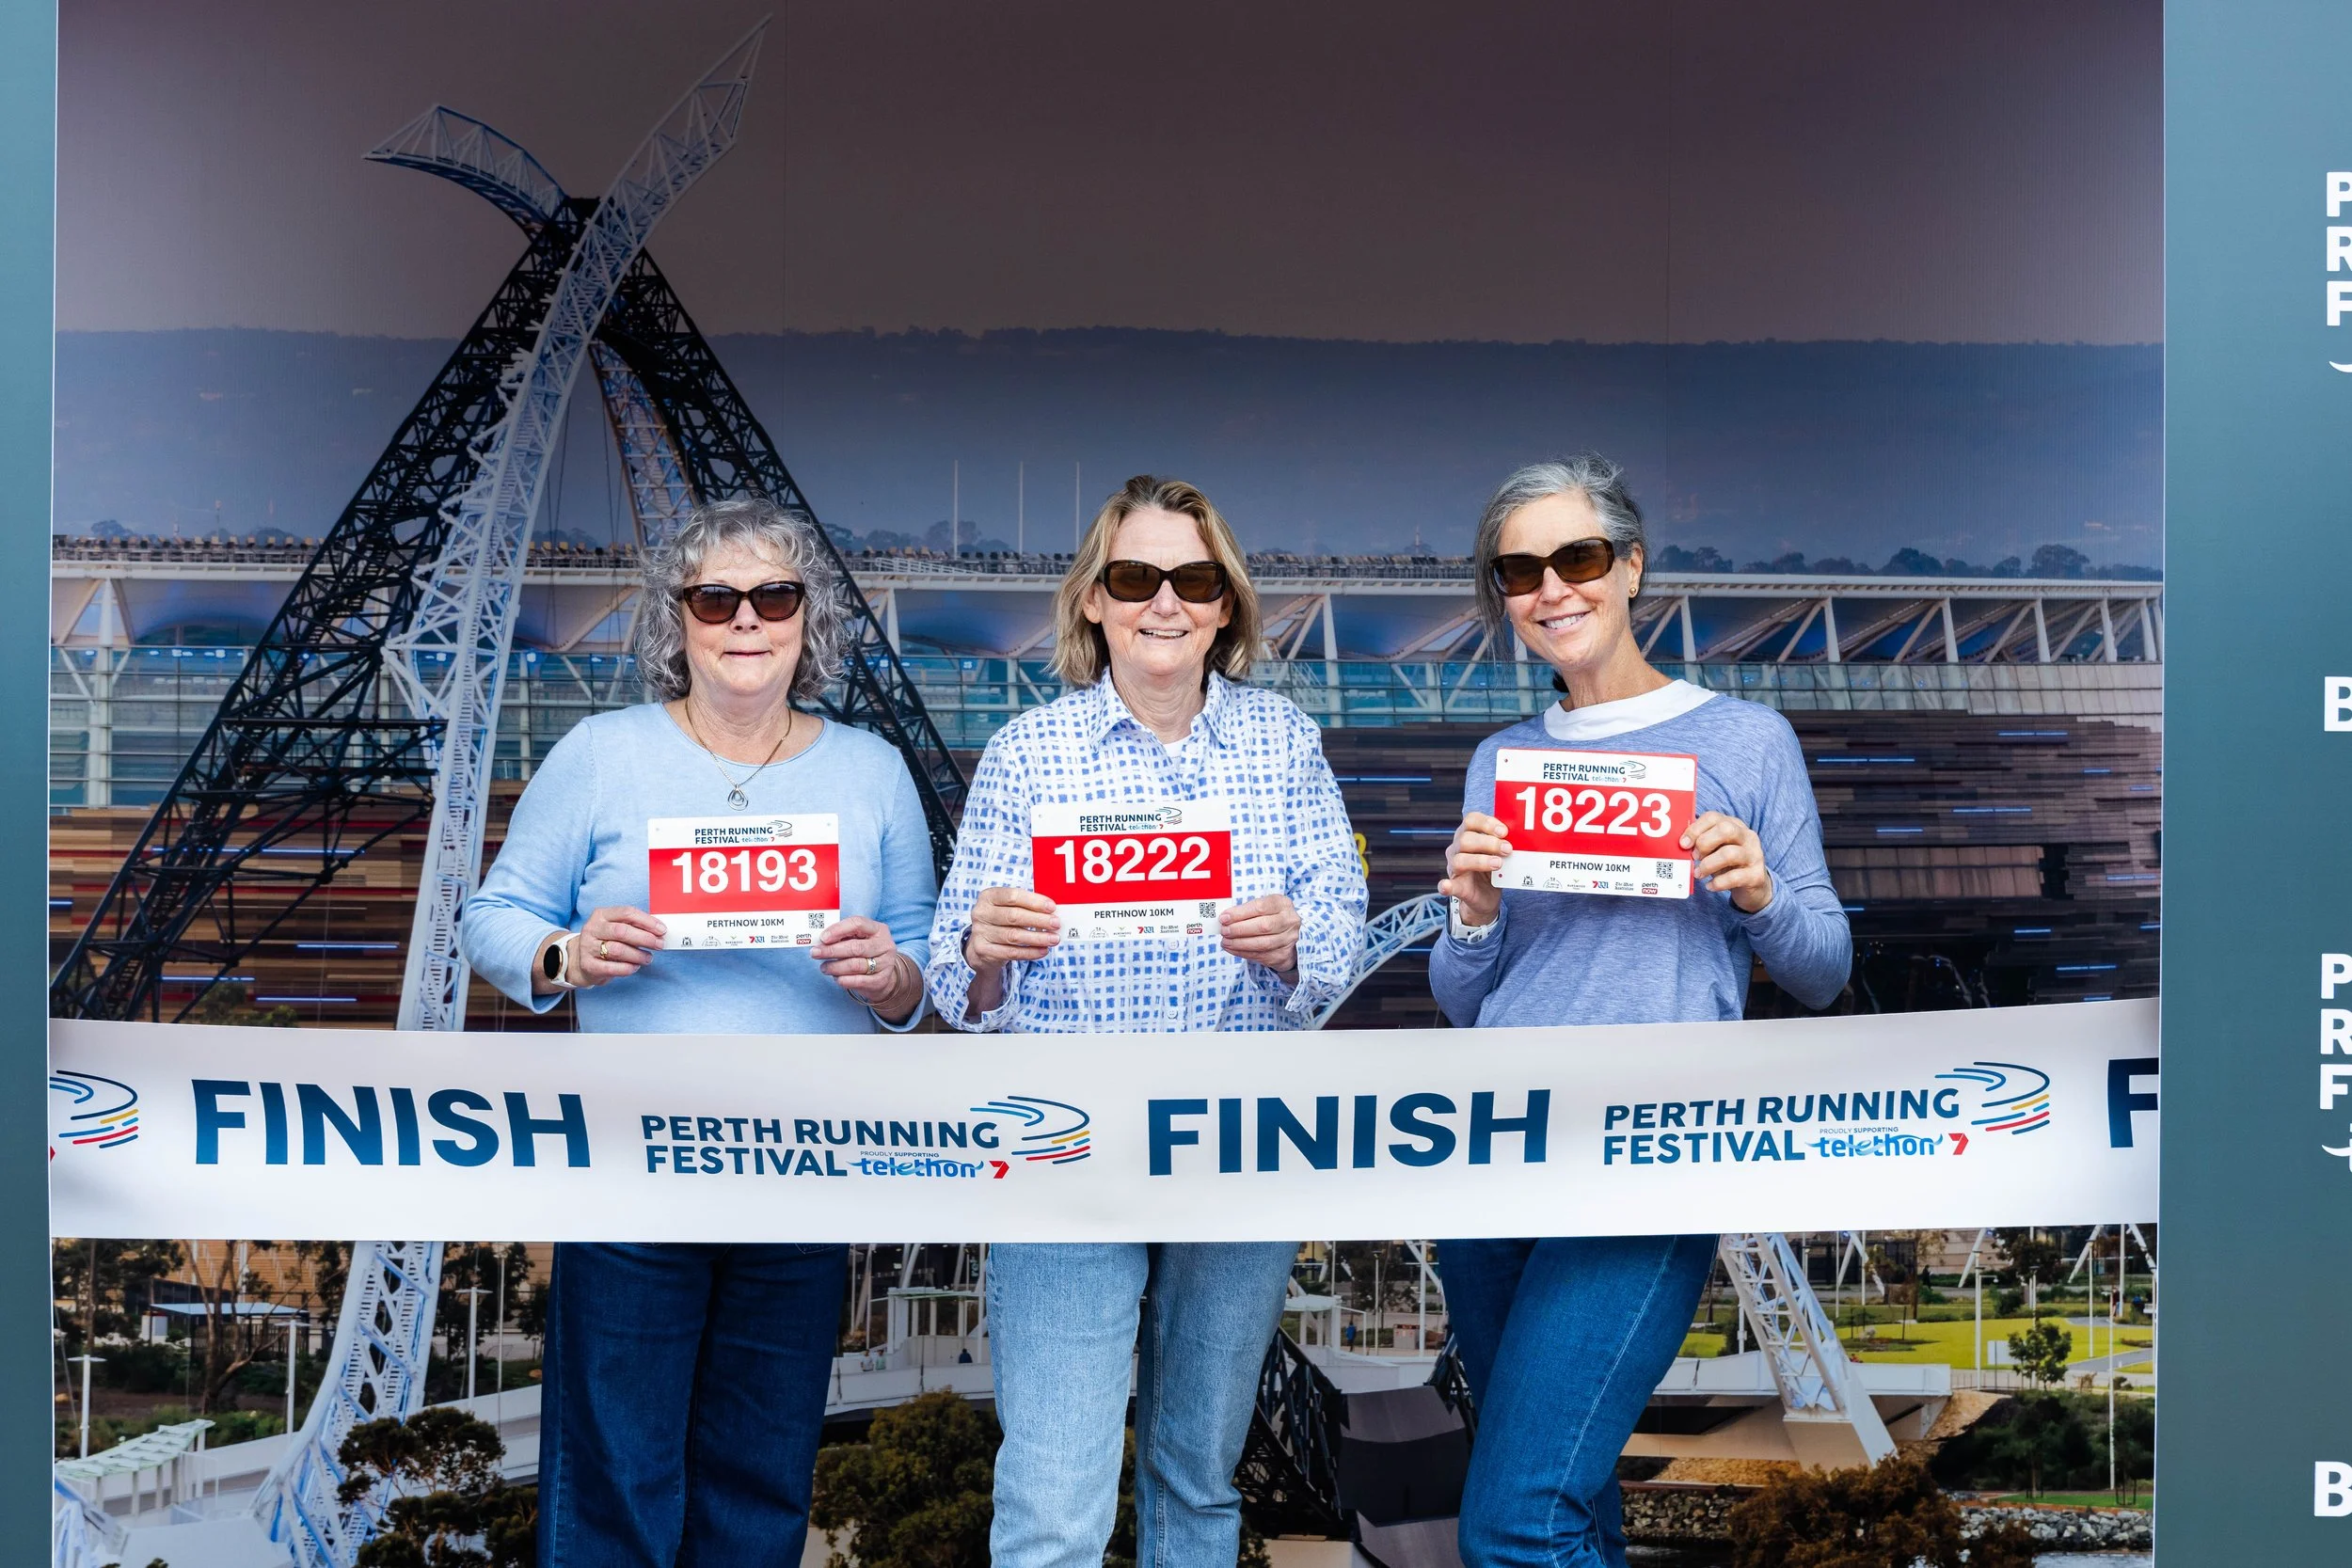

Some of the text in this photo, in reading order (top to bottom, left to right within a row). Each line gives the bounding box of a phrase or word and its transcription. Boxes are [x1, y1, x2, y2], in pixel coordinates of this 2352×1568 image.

[1543, 772, 1589, 782] FESTIVAL
[1544, 763, 1626, 774] PERTH RUNNING
[1117, 814, 1162, 822] RUNNING
[1516, 786, 1671, 837] 18223
[729, 827, 773, 835] RUNNING
[1080, 824, 1126, 832] FESTIVAL
[672, 848, 818, 894] 18193
[1054, 836, 1211, 883] 18222
[1549, 861, 1630, 872] PERTHNOW 10KM
[707, 919, 759, 927] PERTHNOW
[1094, 910, 1148, 918] PERTHNOW
[1604, 1088, 1960, 1130] PERTH RUNNING
[191, 1079, 591, 1167] FINISH
[641, 1115, 1000, 1148] PERTH RUNNING
[1148, 1089, 1551, 1176] FINISH
[1603, 1131, 1805, 1165] FESTIVAL
[1820, 1133, 1936, 1158] telethon
[646, 1145, 847, 1176] FESTIVAL
[860, 1157, 977, 1178] telethon
